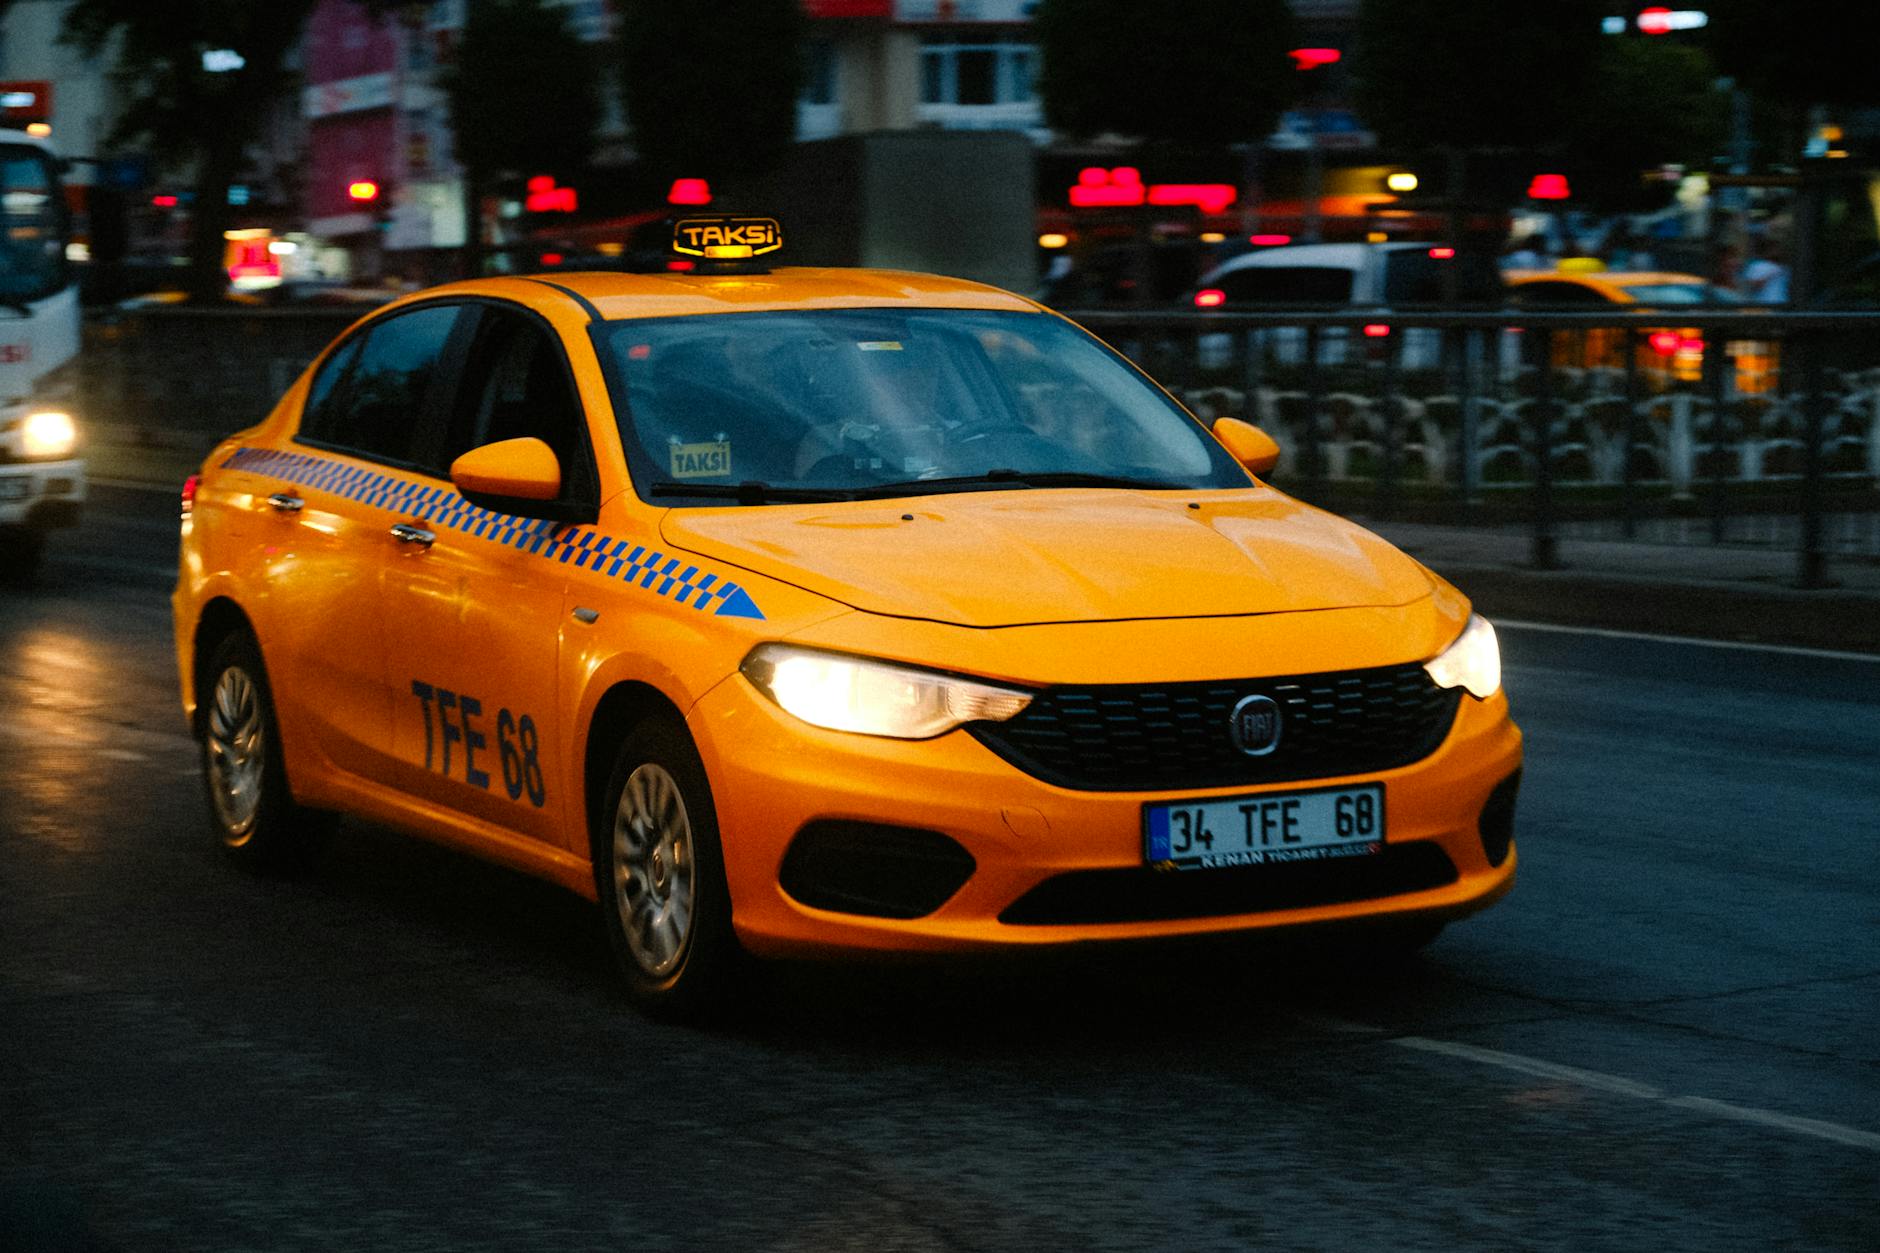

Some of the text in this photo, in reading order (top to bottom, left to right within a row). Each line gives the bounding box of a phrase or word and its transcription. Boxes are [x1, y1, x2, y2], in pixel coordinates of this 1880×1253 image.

[411, 679, 545, 808] TFE 68
[1171, 794, 1374, 853] 34 TFE 68
[1201, 851, 1265, 868] KENAN
